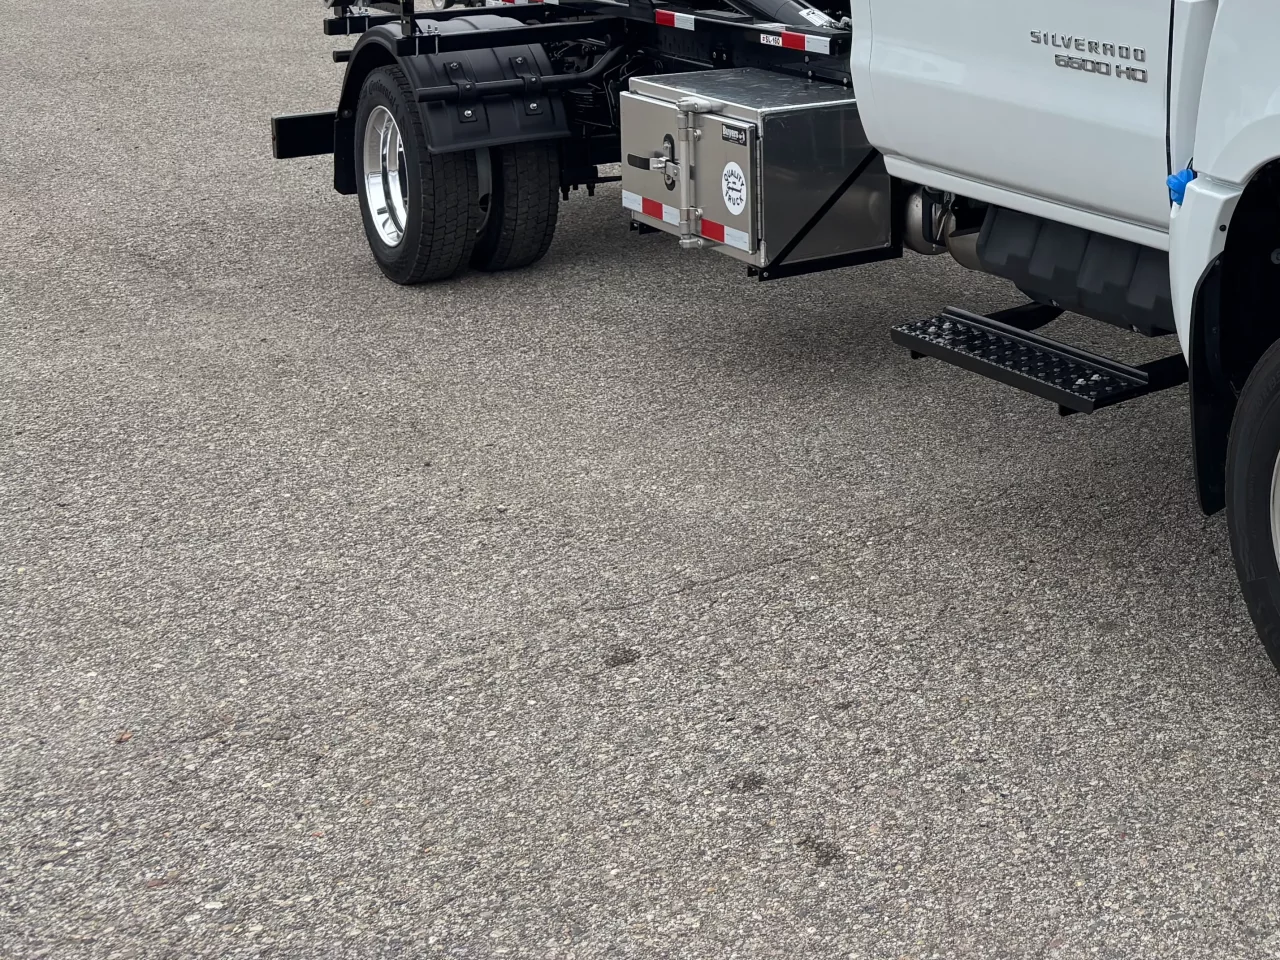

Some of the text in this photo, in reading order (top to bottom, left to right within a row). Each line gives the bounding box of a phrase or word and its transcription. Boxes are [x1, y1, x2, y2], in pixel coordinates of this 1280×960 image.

[1030, 29, 1147, 63] SILVERADO
[1115, 63, 1149, 84] HD
[722, 125, 739, 139] Buyers
[723, 168, 745, 187] QUALITY
[724, 190, 744, 207] TRUCK
